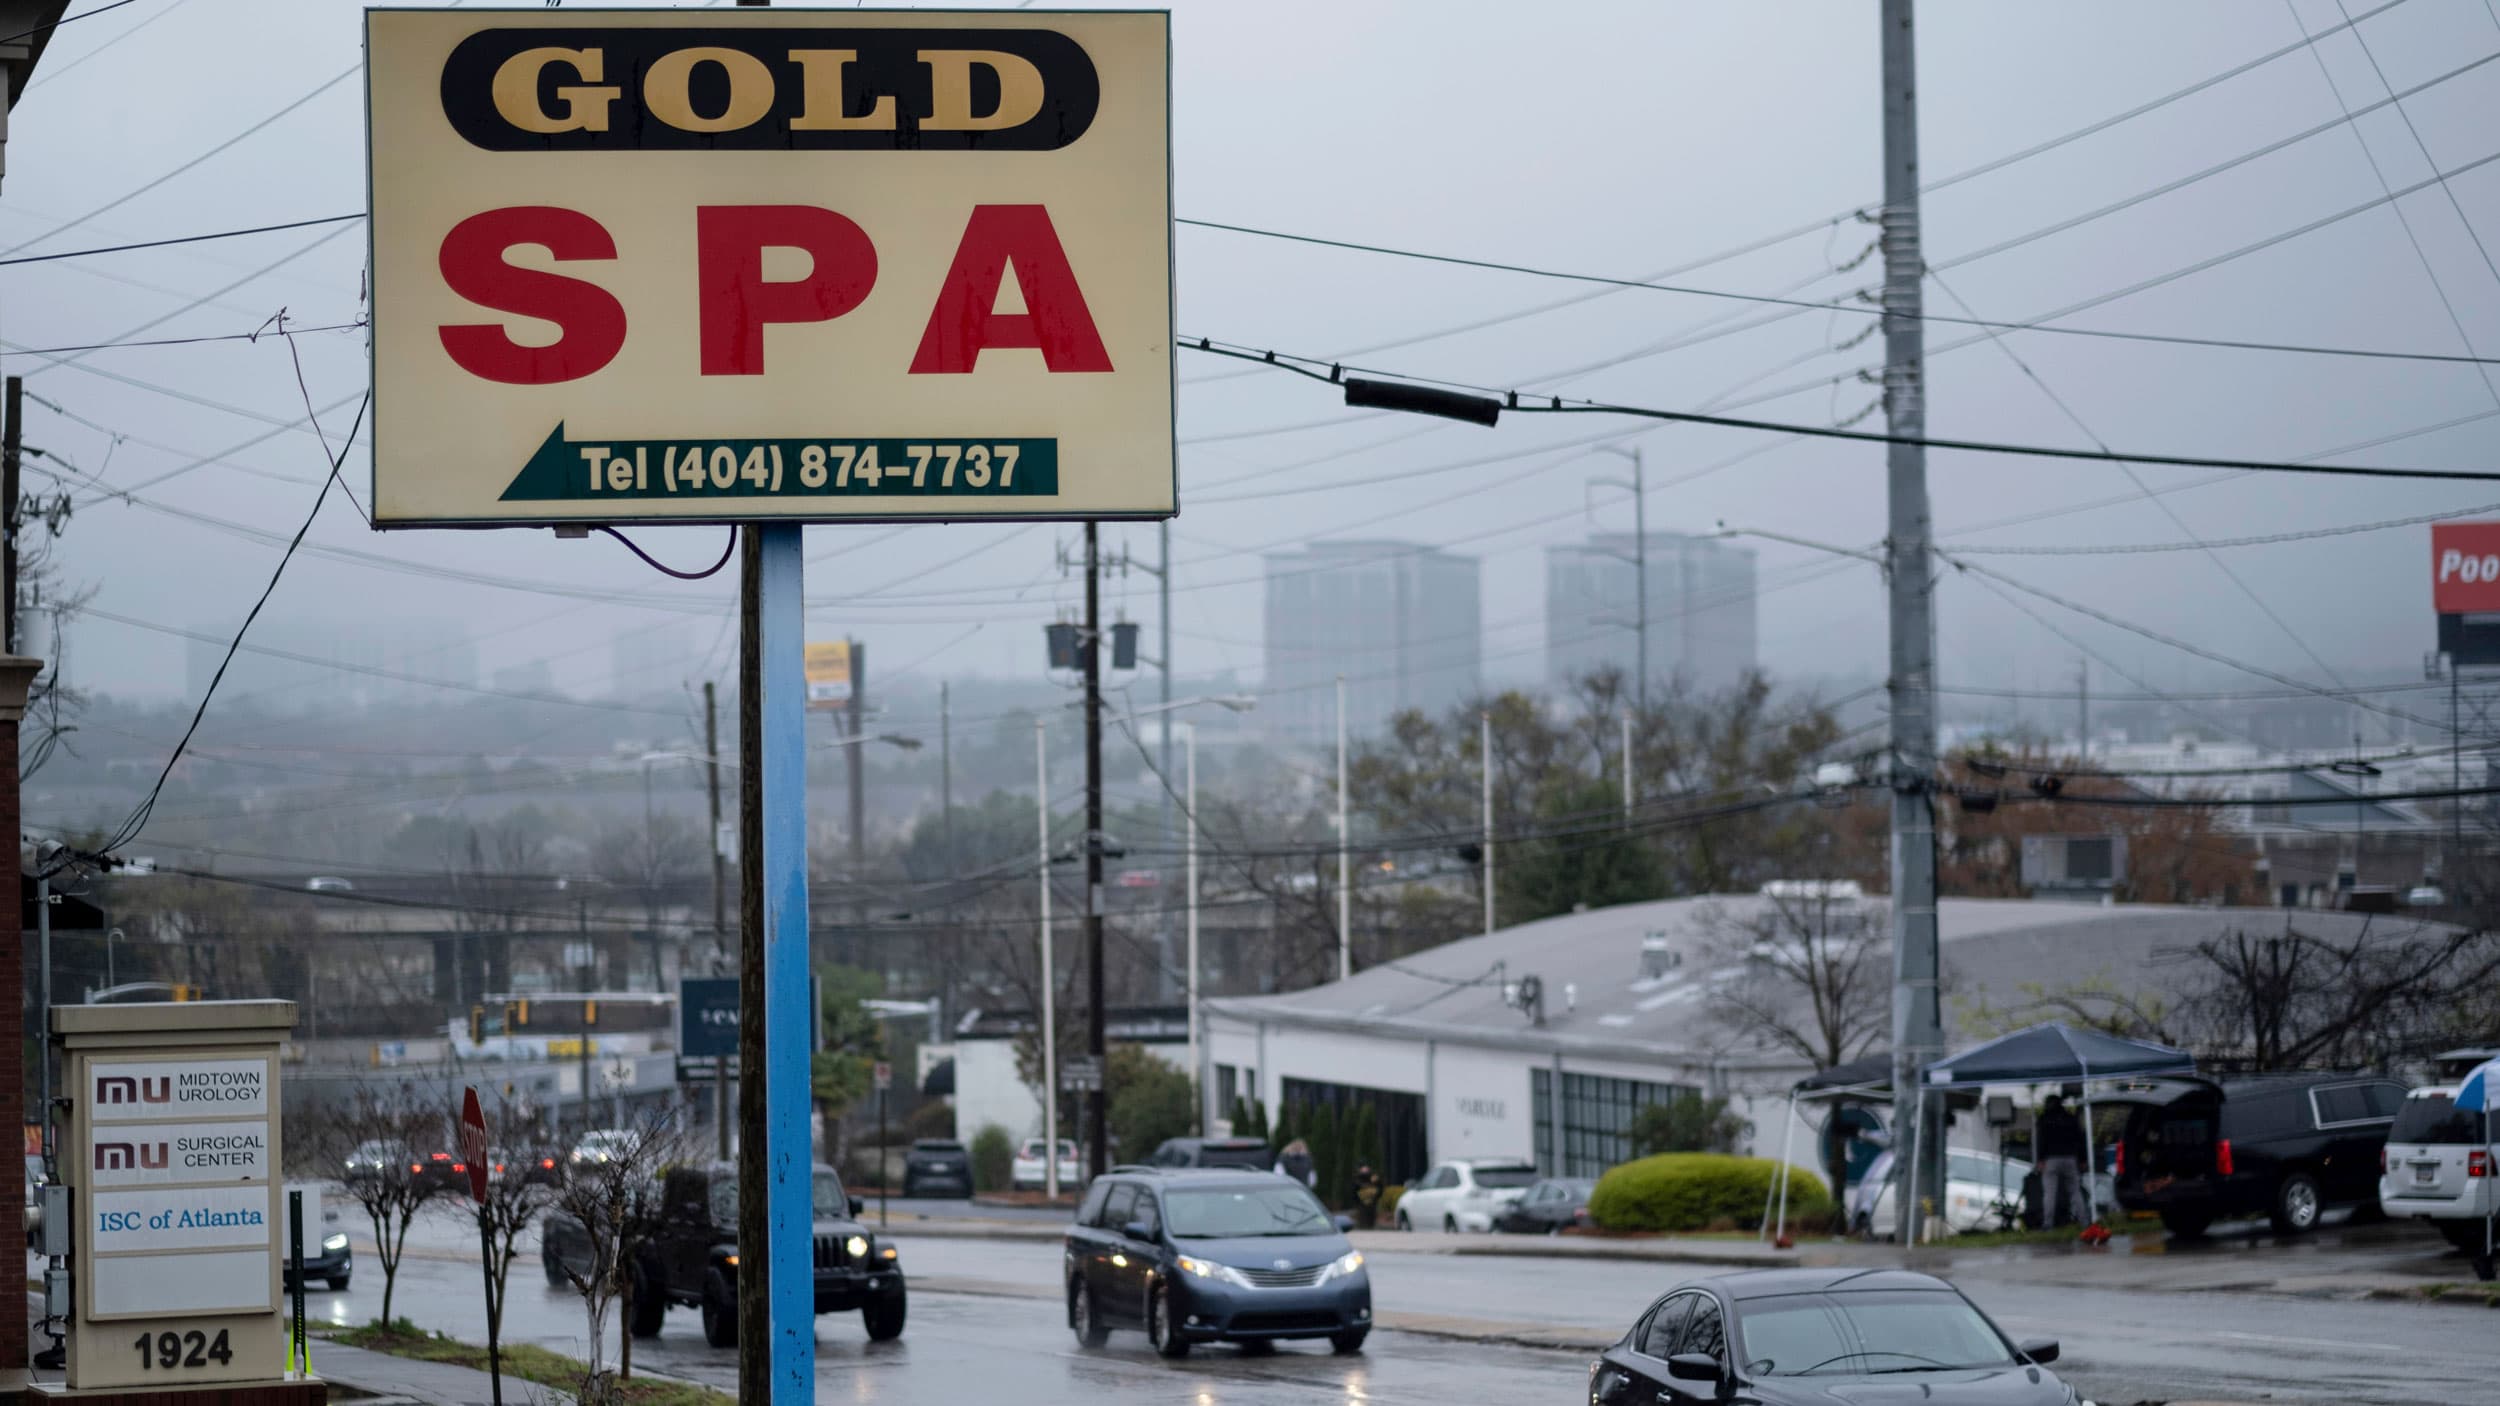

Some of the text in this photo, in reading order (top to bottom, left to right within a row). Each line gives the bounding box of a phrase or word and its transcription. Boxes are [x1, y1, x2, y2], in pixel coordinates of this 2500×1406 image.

[492, 46, 1045, 133] GOLD
[438, 204, 1115, 385] SPA
[580, 444, 1020, 492] Tel (404) 874-7737
[179, 1072, 260, 1086] MIDTOWN
[179, 1087, 261, 1102] UROLOGY
[177, 1135, 264, 1151] SURGICAL
[184, 1152, 255, 1168] CENTER
[99, 1207, 263, 1232] ISC of Atlanta
[134, 1329, 233, 1370] 1924
